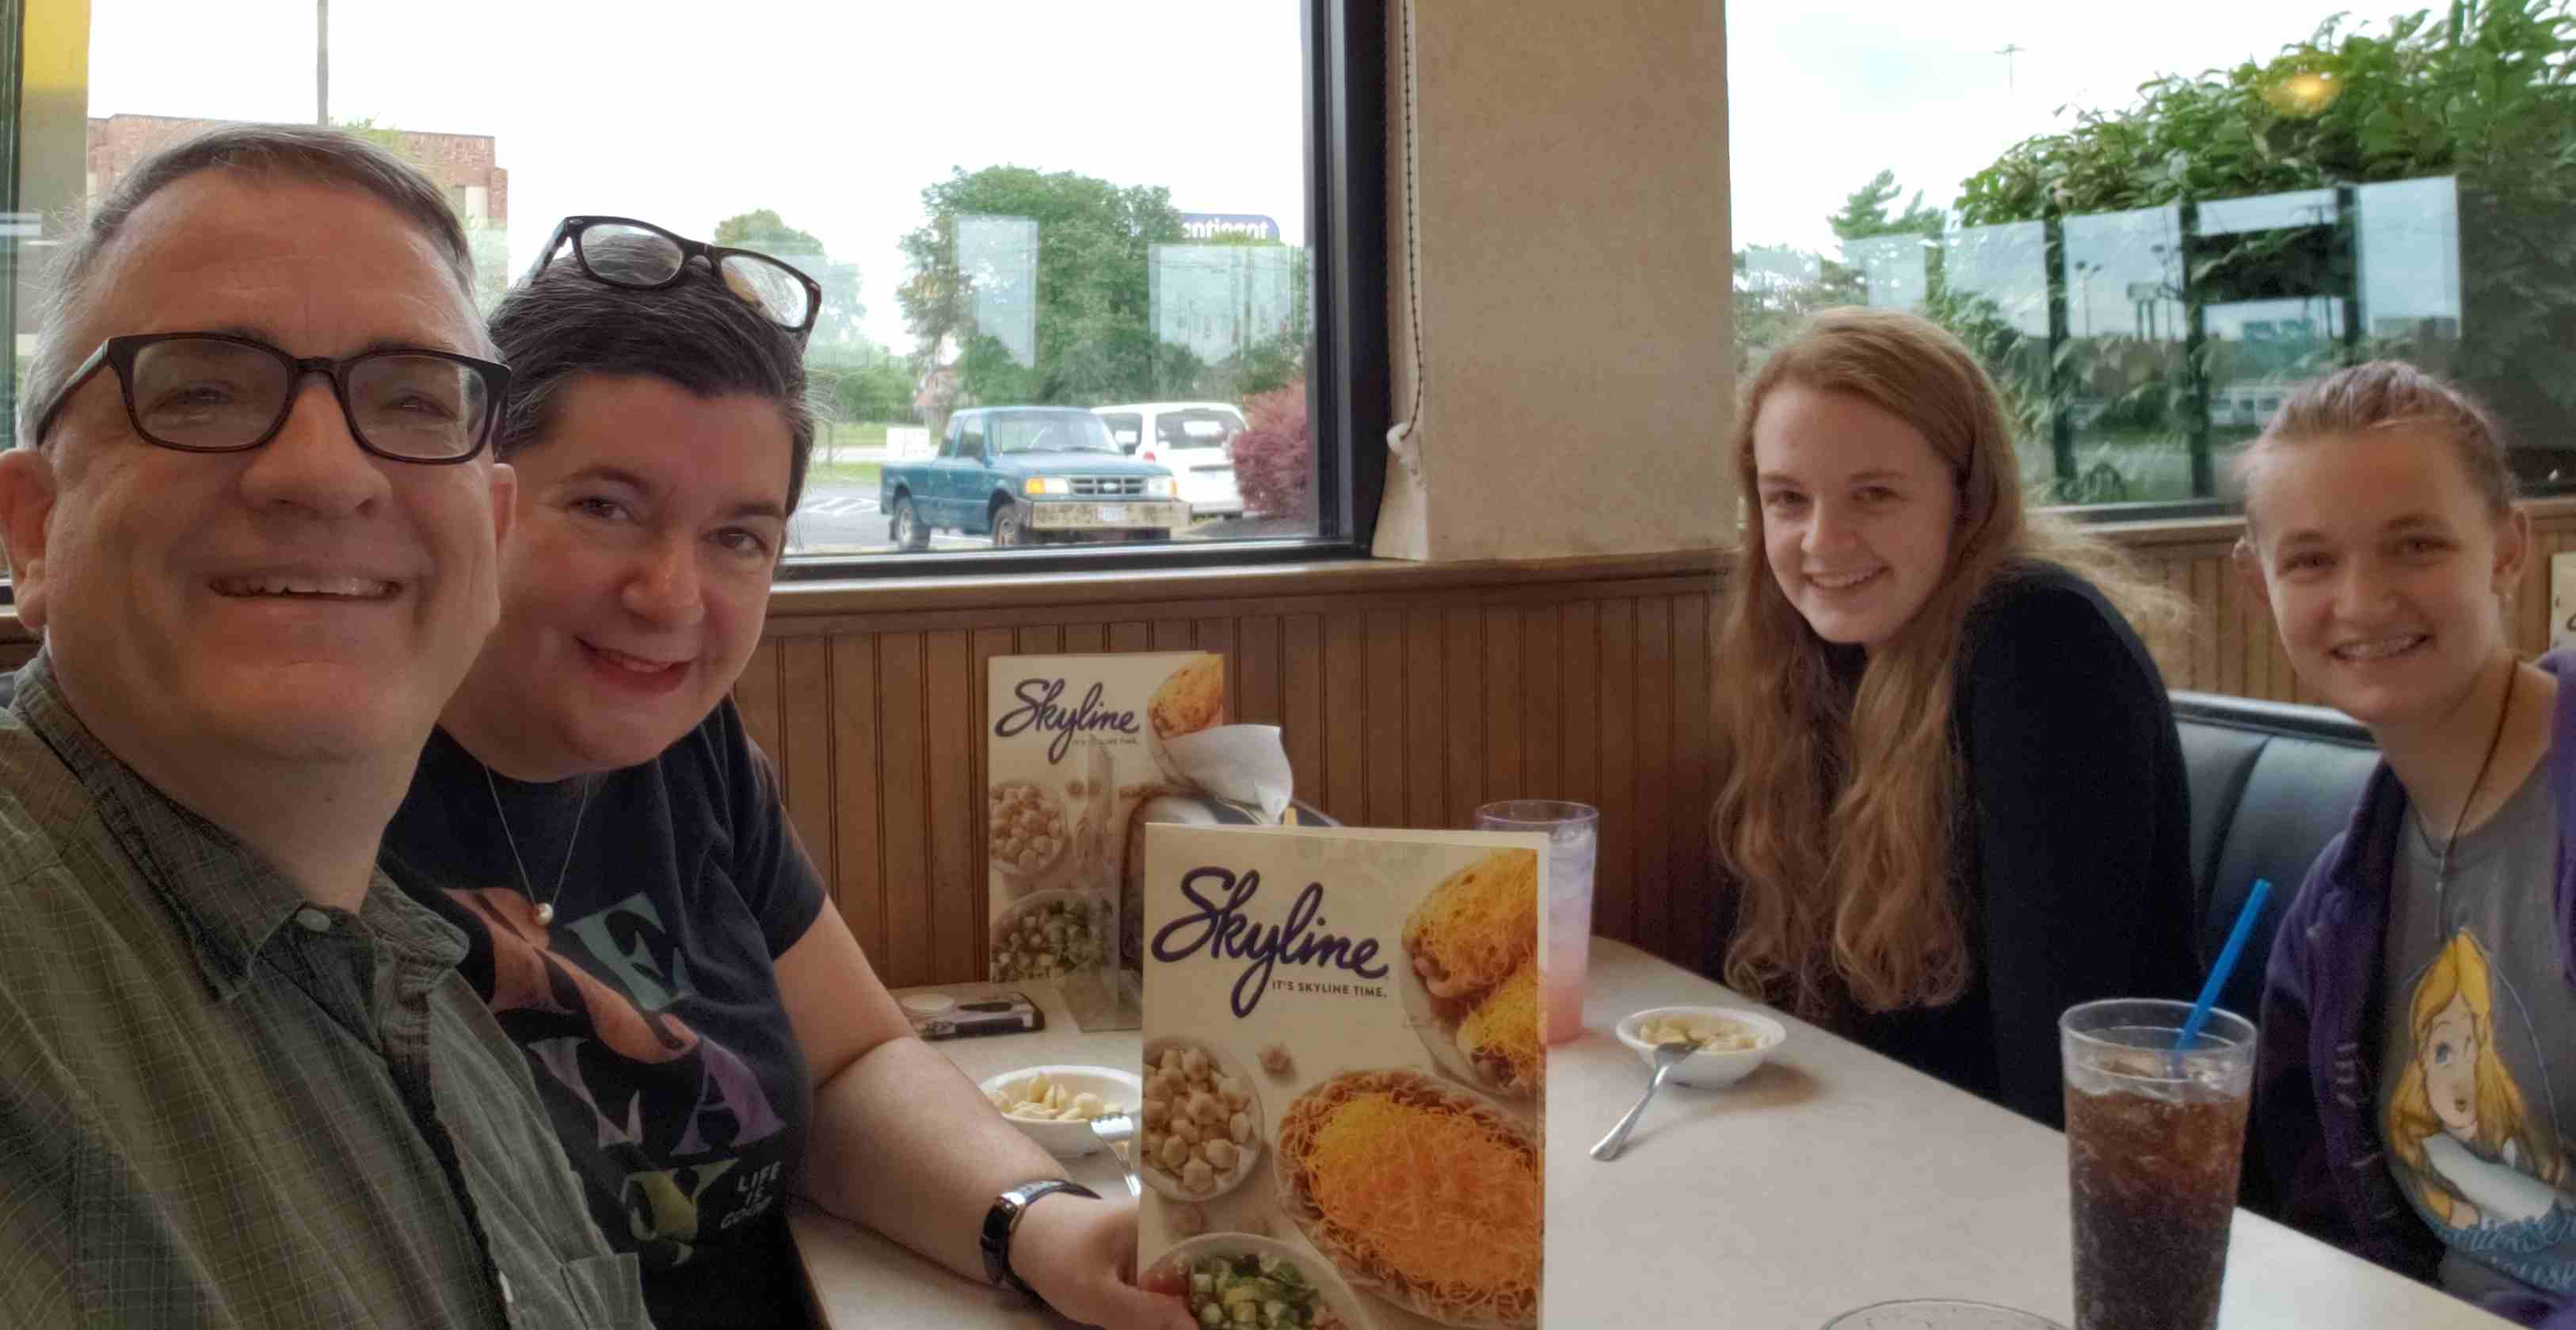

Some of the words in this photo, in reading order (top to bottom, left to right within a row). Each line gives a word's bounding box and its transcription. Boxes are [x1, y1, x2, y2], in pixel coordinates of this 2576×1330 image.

[994, 679, 1140, 764] Skyline
[1150, 866, 1389, 1019] Skyline
[1272, 979, 1294, 991] IT'S
[1298, 981, 1350, 995] SKYLINE
[1353, 985, 1388, 999] TIME.
